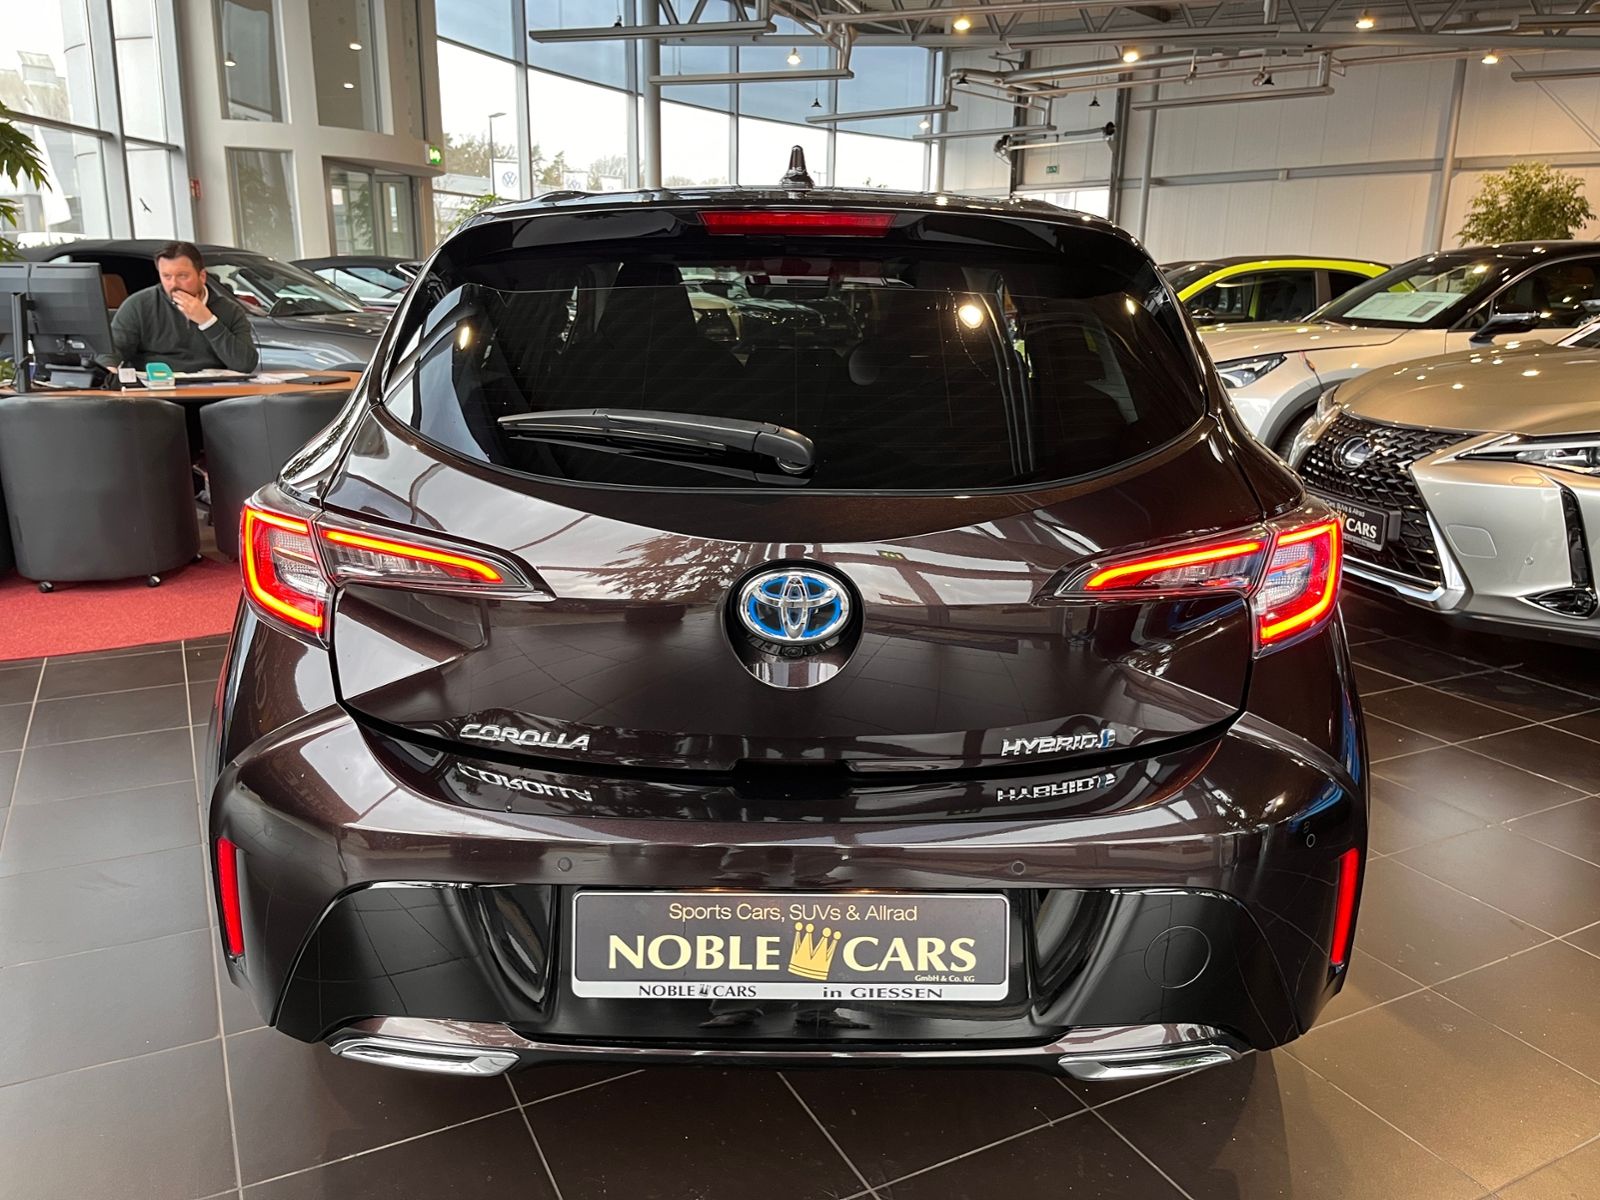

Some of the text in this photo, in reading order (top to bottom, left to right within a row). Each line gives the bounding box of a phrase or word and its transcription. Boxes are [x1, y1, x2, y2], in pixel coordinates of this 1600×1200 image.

[1346, 518, 1377, 539] CARS
[459, 723, 590, 750] COROLLA
[1001, 733, 1098, 756] HYBRID
[669, 903, 918, 922] Sports Cars, SUVs & Allrad
[608, 934, 976, 972] NOBLE CARS
[914, 974, 940, 982] GmbH
[948, 975, 961, 983] Co.
[639, 985, 943, 998] NOBLE CARS in GIESSEN
